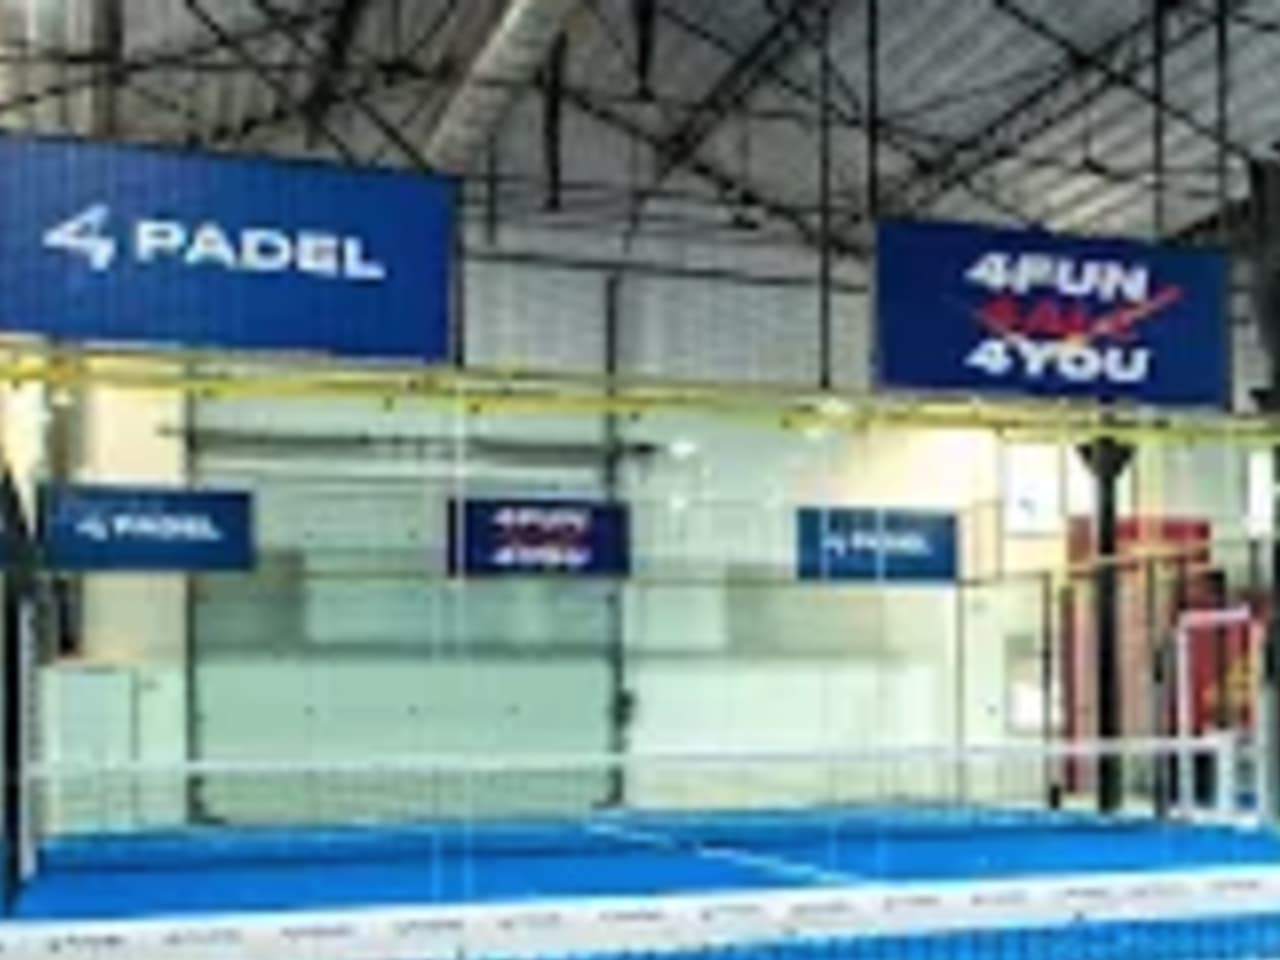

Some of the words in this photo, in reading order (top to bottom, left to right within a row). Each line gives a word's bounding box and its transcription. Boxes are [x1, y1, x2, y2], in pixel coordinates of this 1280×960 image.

[43, 204, 116, 271] 4
[135, 219, 386, 280] PADEL
[964, 253, 1148, 299] 4FUN
[964, 340, 1149, 382] 4YOU
